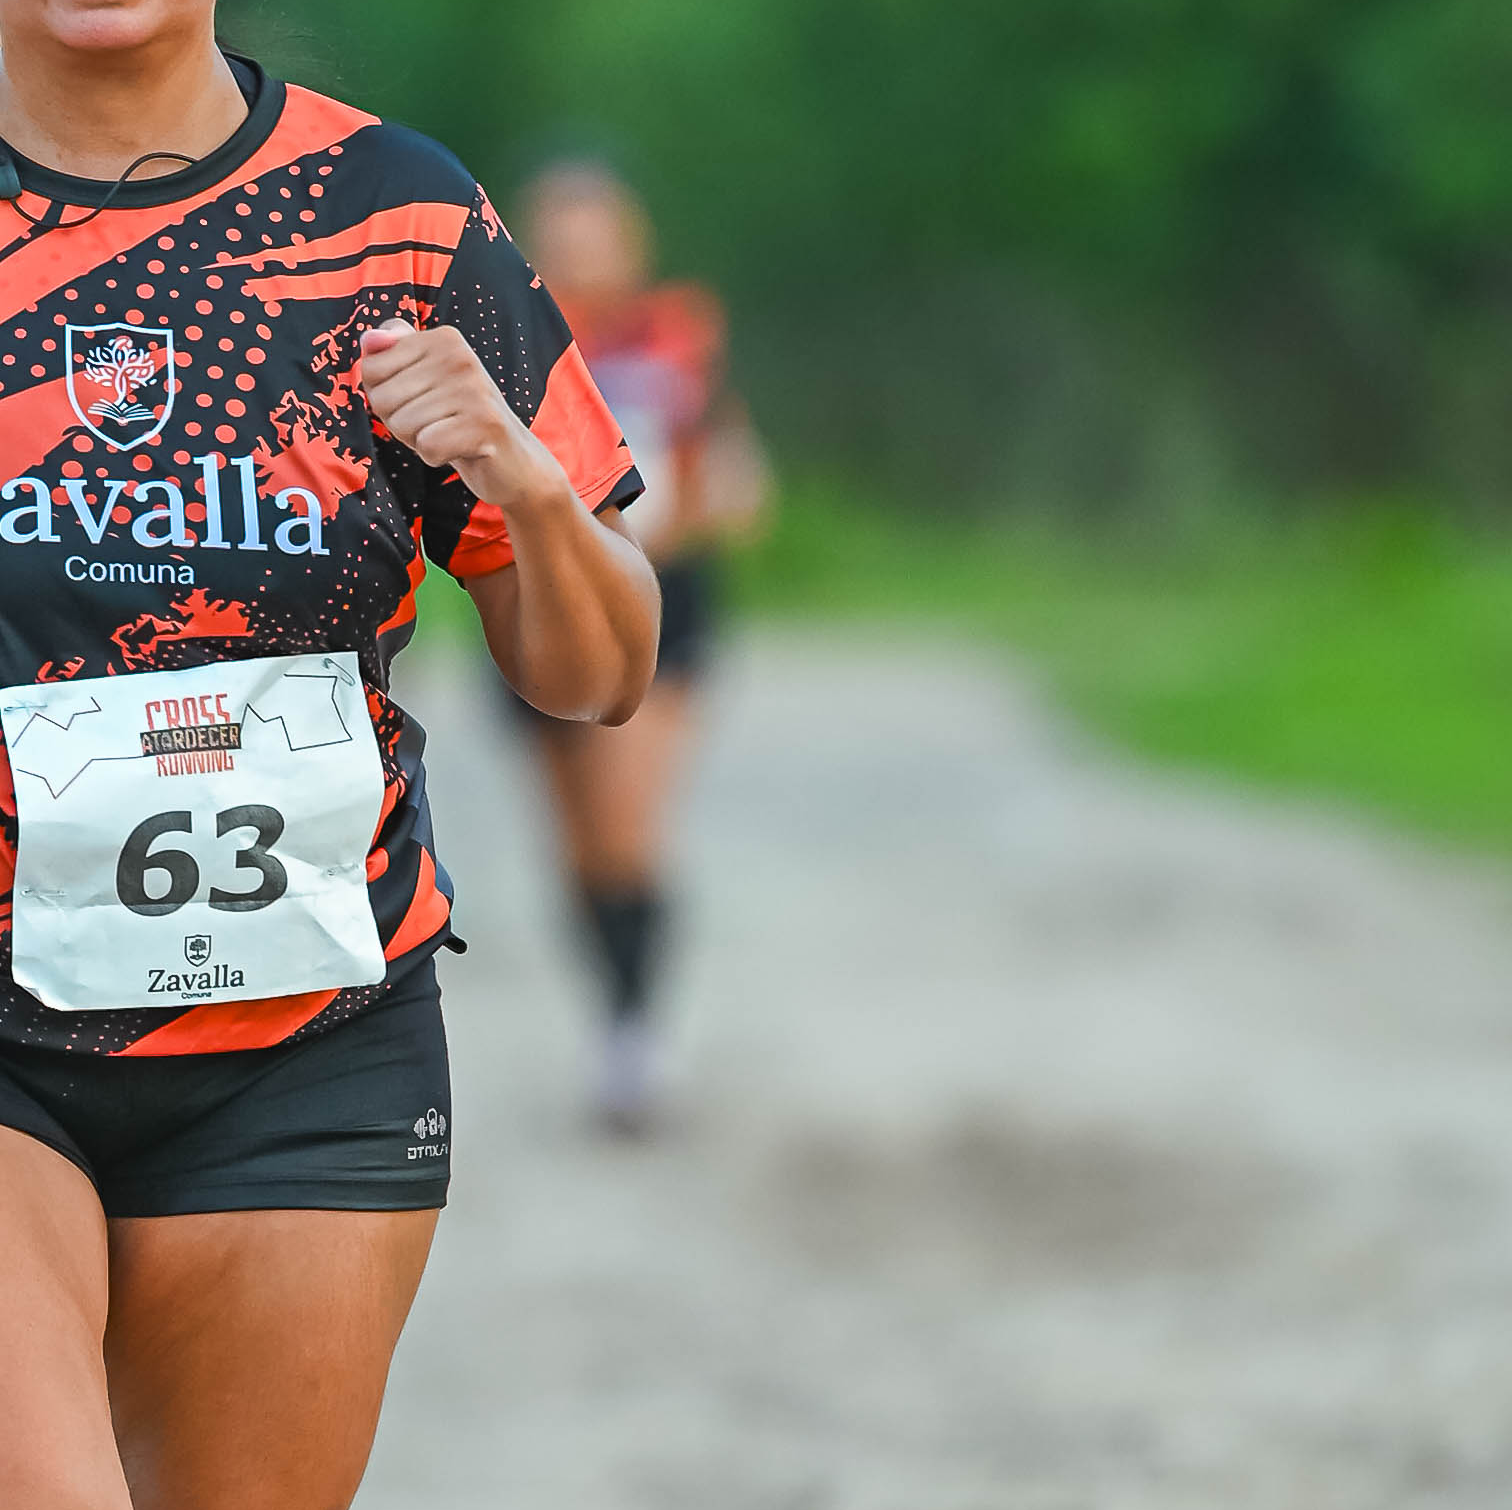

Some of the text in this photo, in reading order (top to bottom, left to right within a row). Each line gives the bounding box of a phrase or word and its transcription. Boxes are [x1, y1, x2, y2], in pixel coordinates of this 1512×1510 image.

[64, 555, 195, 585] Comuna
[145, 693, 230, 731] CROSS
[141, 725, 240, 754] ATARDECER
[155, 750, 234, 777] RUNNING
[115, 804, 289, 917] 63
[148, 963, 245, 993] Zavalla
